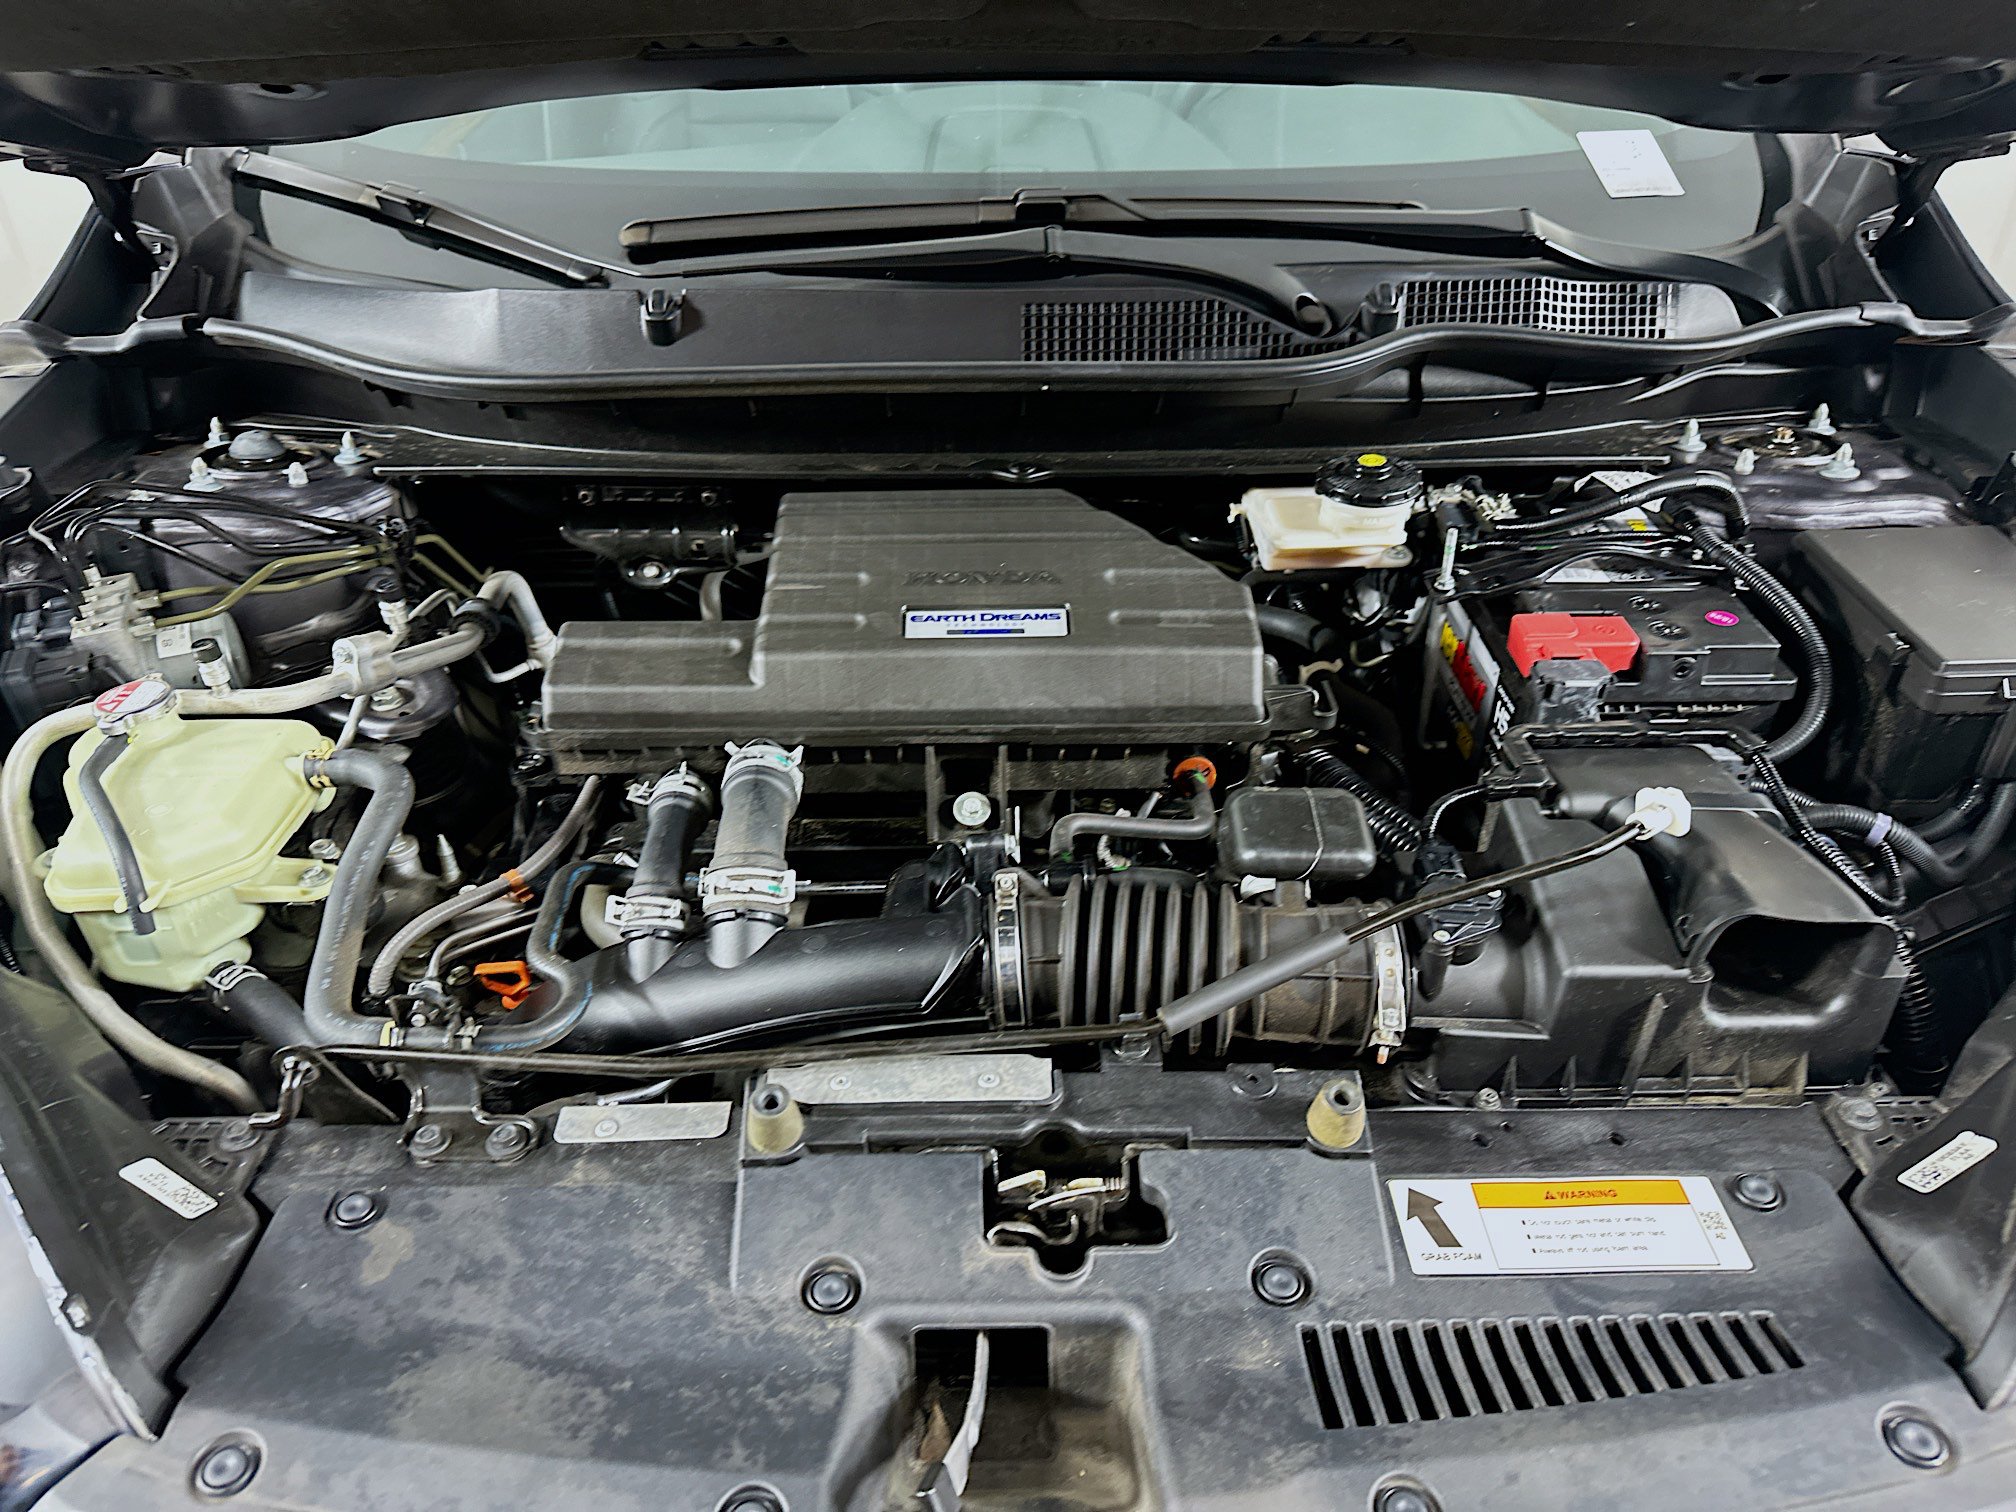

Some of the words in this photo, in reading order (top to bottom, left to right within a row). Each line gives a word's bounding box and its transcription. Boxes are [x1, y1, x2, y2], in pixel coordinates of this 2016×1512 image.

[910, 614, 976, 623] EARTH
[980, 612, 1061, 621] DREAMS
[1557, 1188, 1618, 1200] WARNING
